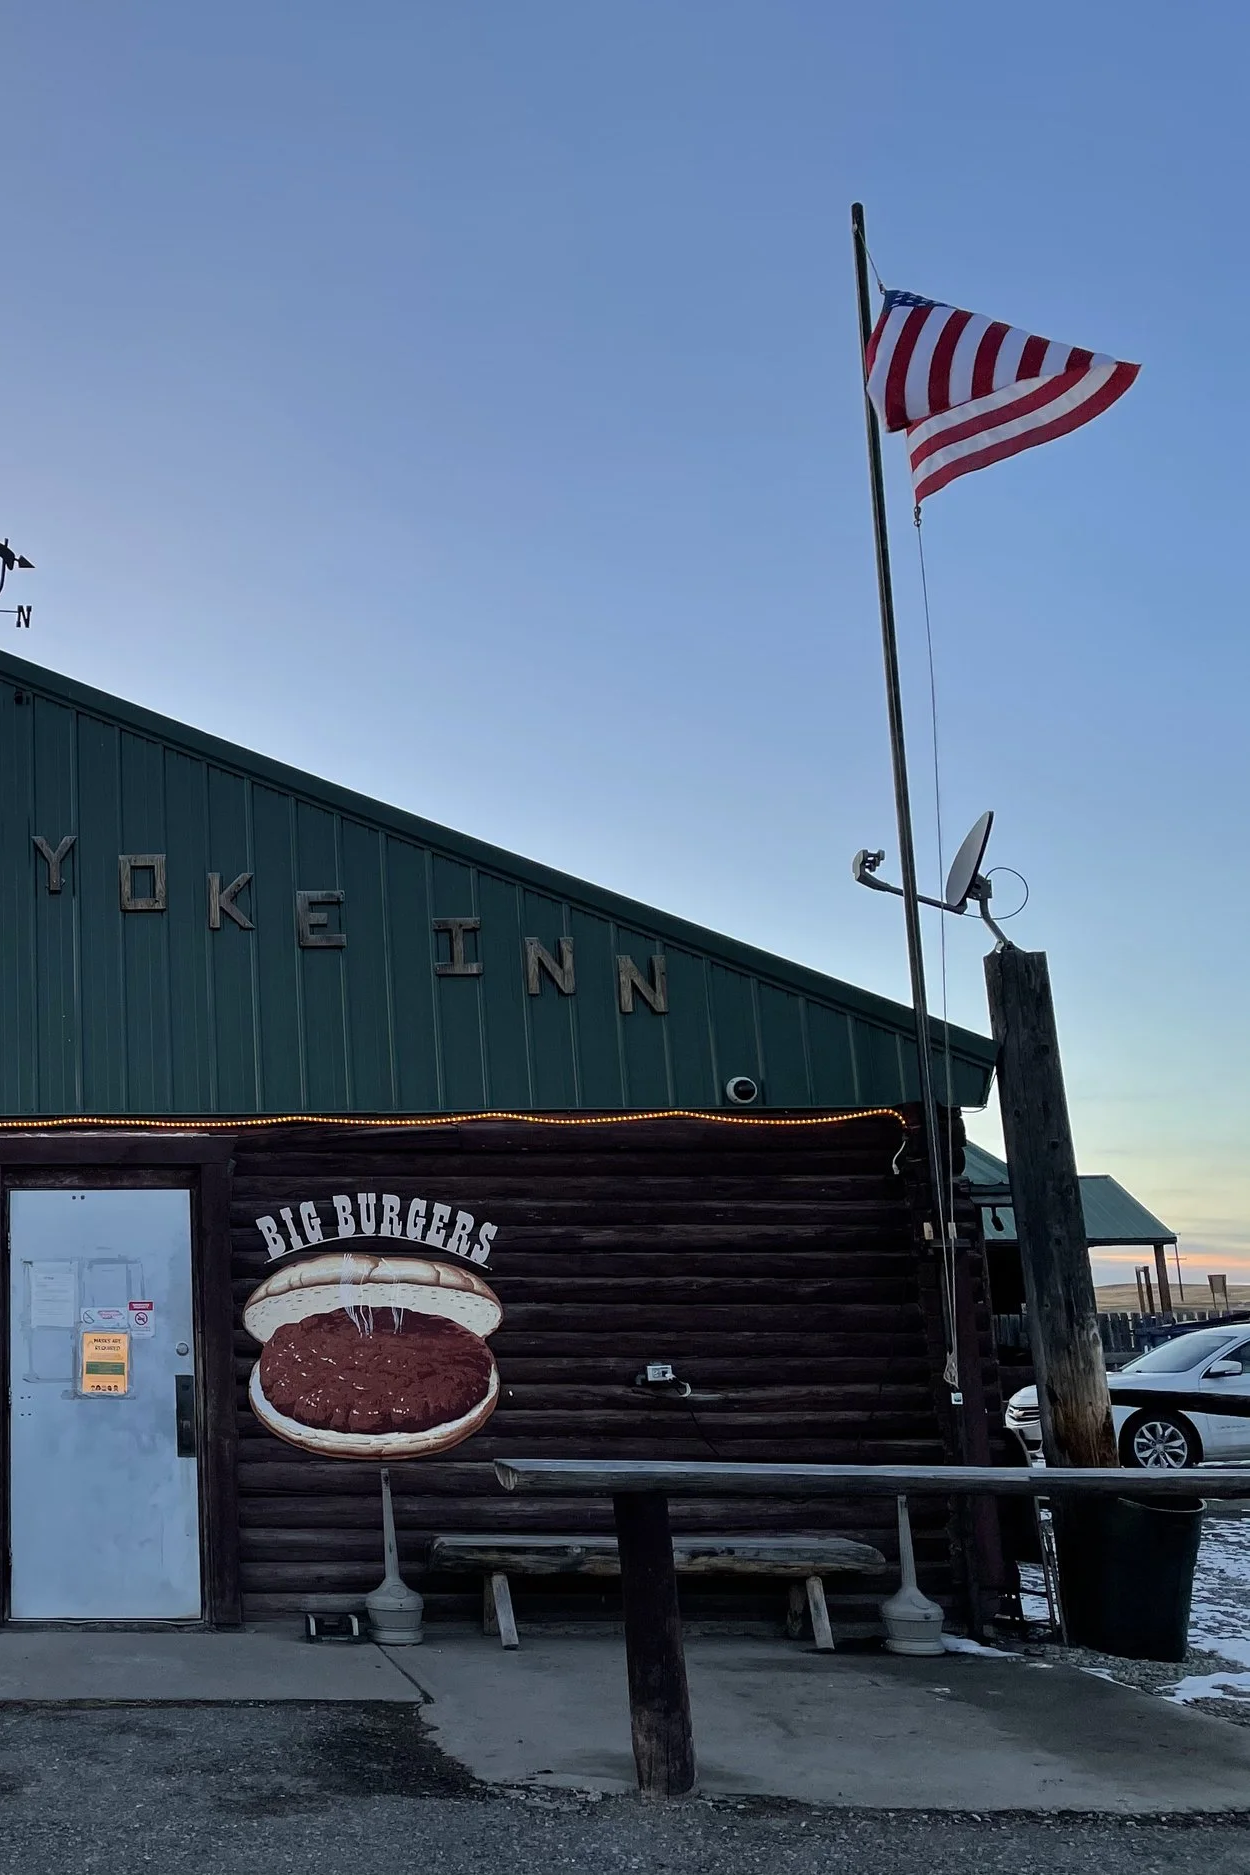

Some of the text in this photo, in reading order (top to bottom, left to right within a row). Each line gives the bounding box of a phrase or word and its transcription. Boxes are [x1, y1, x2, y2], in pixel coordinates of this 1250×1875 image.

[15, 605, 32, 629] N
[31, 835, 347, 949] YOKE
[432, 917, 670, 1014] INN
[255, 1193, 499, 1265] BIG BURGERS
